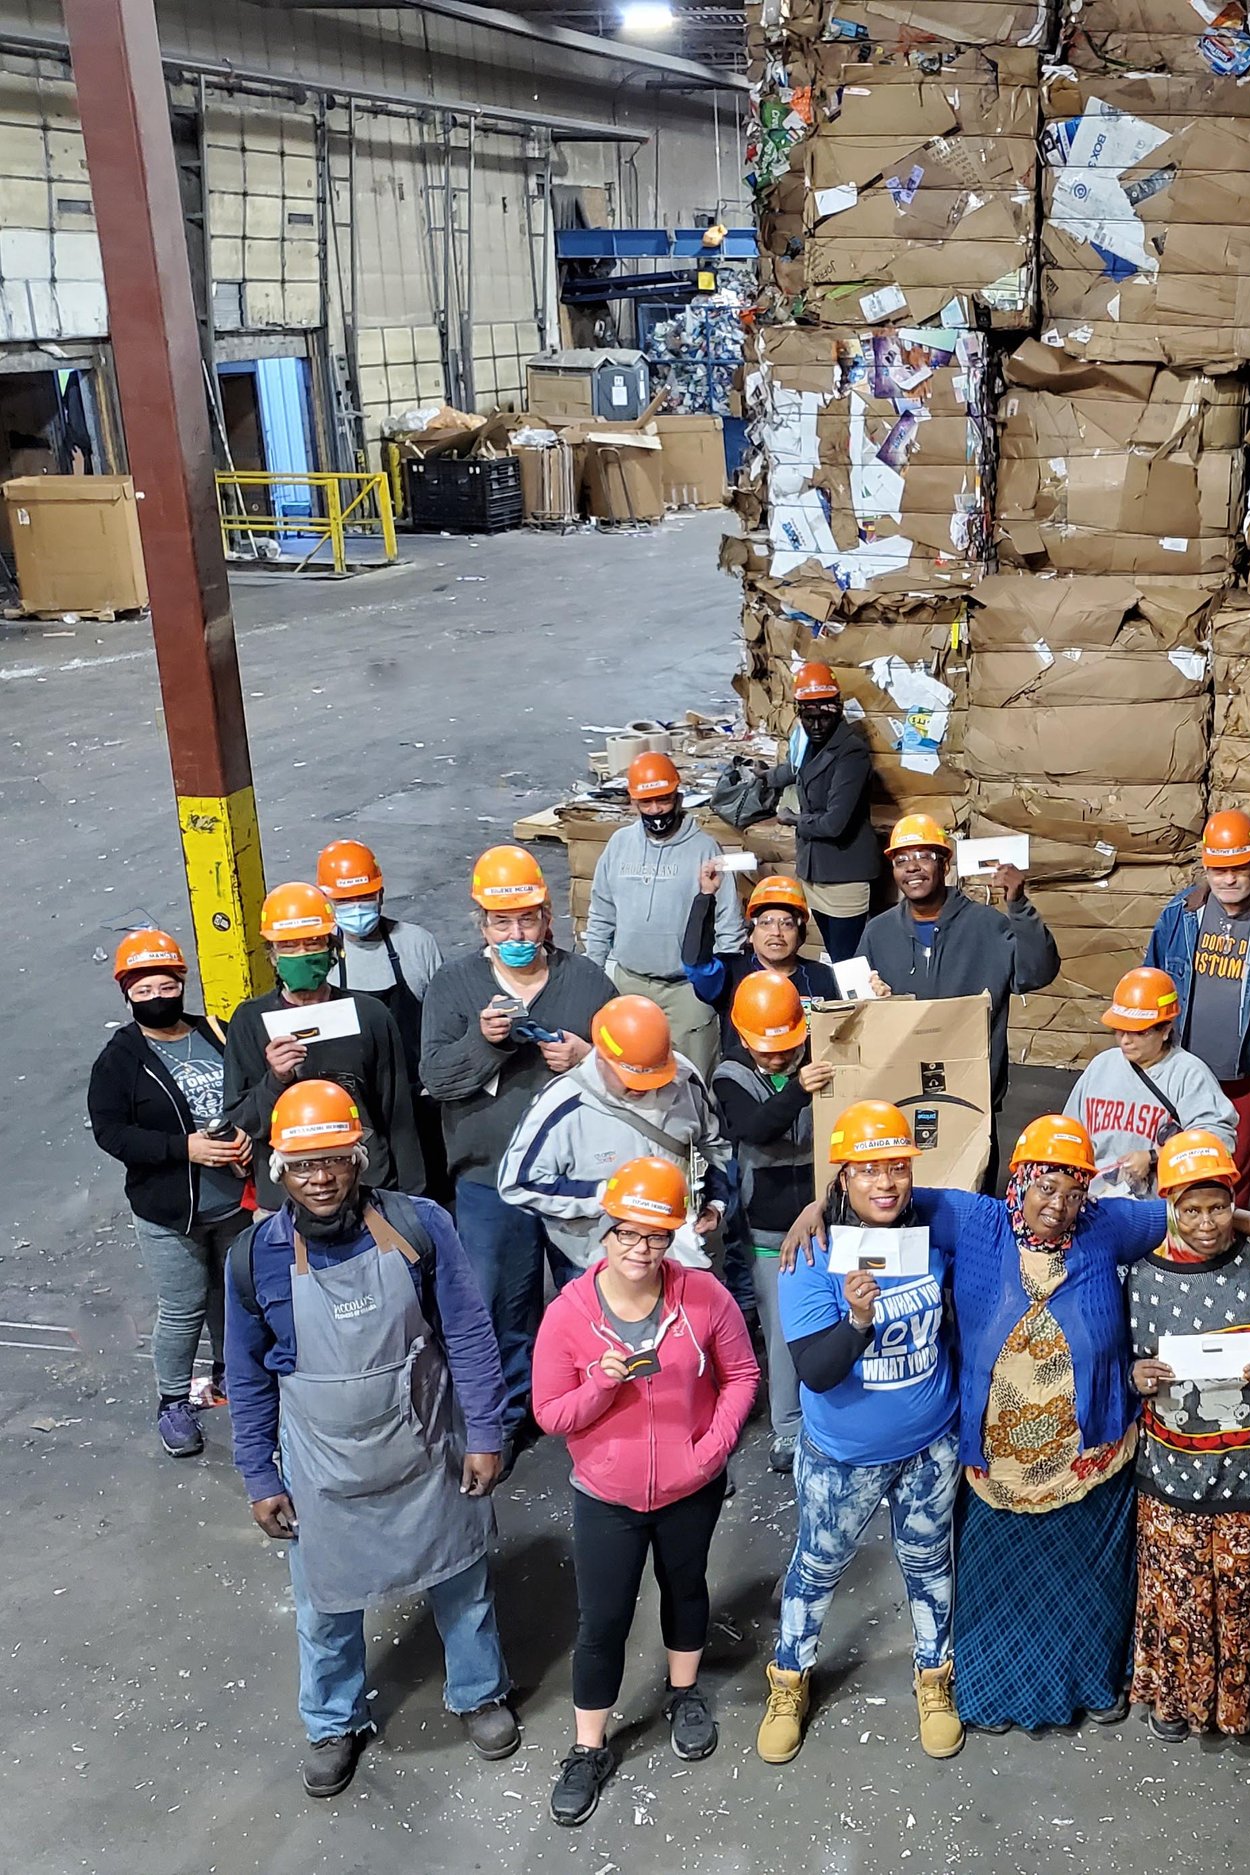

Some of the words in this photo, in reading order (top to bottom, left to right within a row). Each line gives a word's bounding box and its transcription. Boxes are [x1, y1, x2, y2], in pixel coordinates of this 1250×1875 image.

[1090, 133, 1106, 161] BOX
[1086, 1097, 1173, 1142] NEBRASK
[855, 1139, 890, 1150] YOLANDA
[883, 1288, 923, 1320] WHAT
[862, 1356, 905, 1381] WHAT
